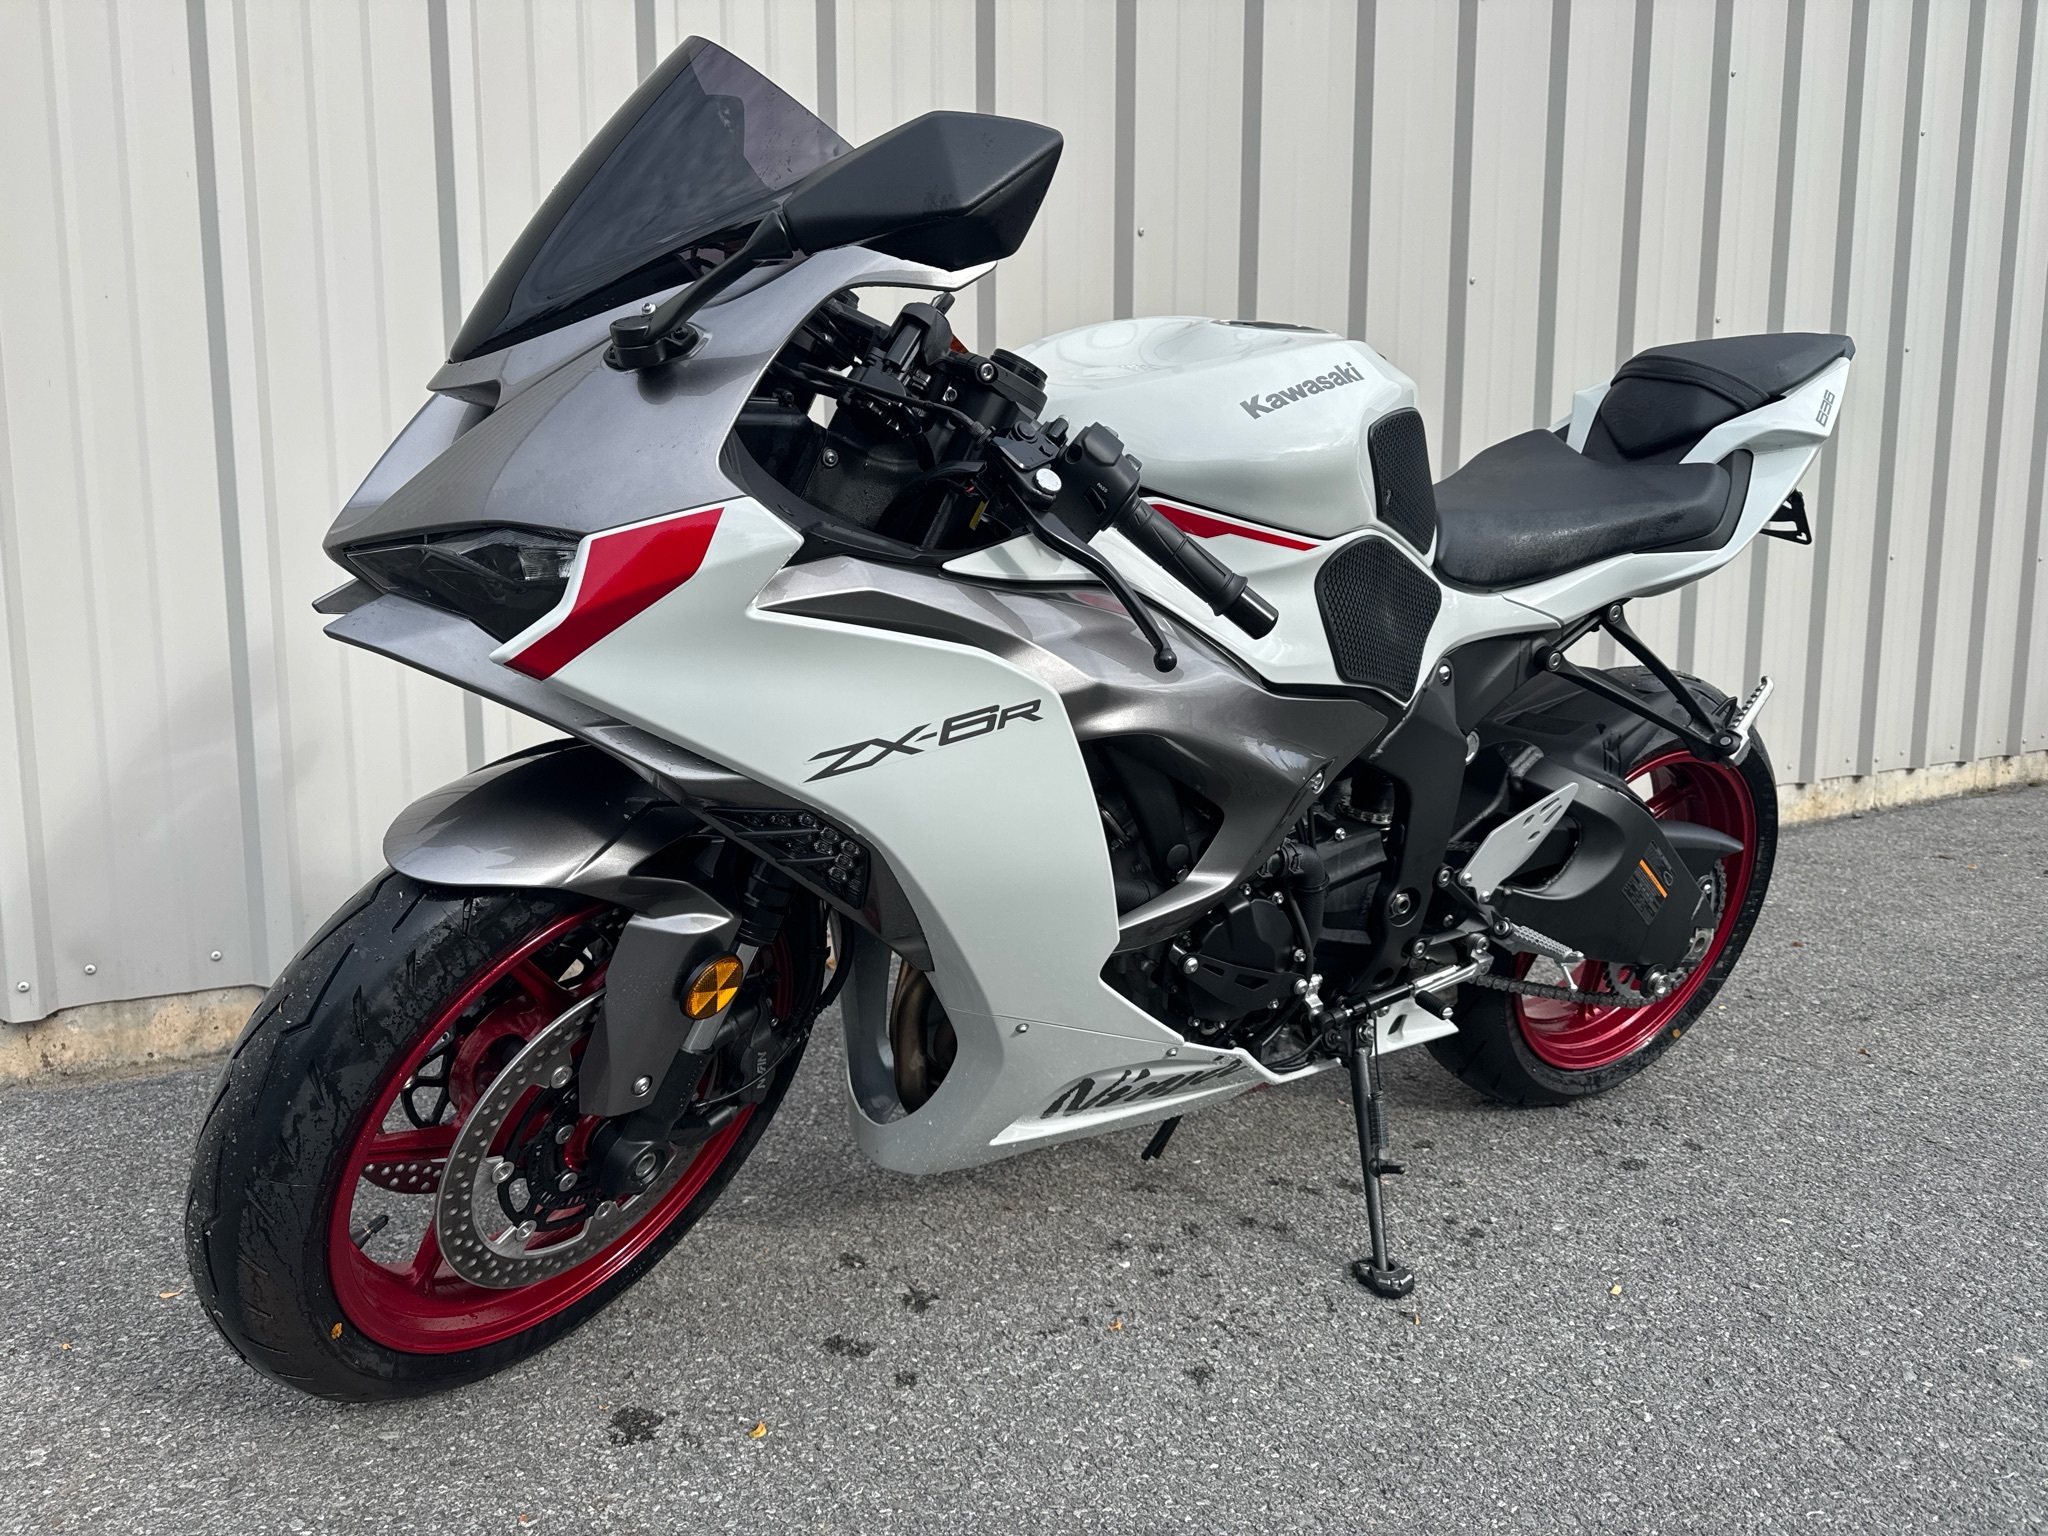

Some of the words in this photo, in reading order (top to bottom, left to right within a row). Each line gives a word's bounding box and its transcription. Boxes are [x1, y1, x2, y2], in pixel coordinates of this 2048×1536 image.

[1239, 361, 1365, 420] Kawasaki
[1815, 389, 1836, 427] 636
[802, 698, 1044, 783] ZX-6R
[756, 1051, 767, 1089] NSSIN
[1040, 1055, 1247, 1119] Ninja
